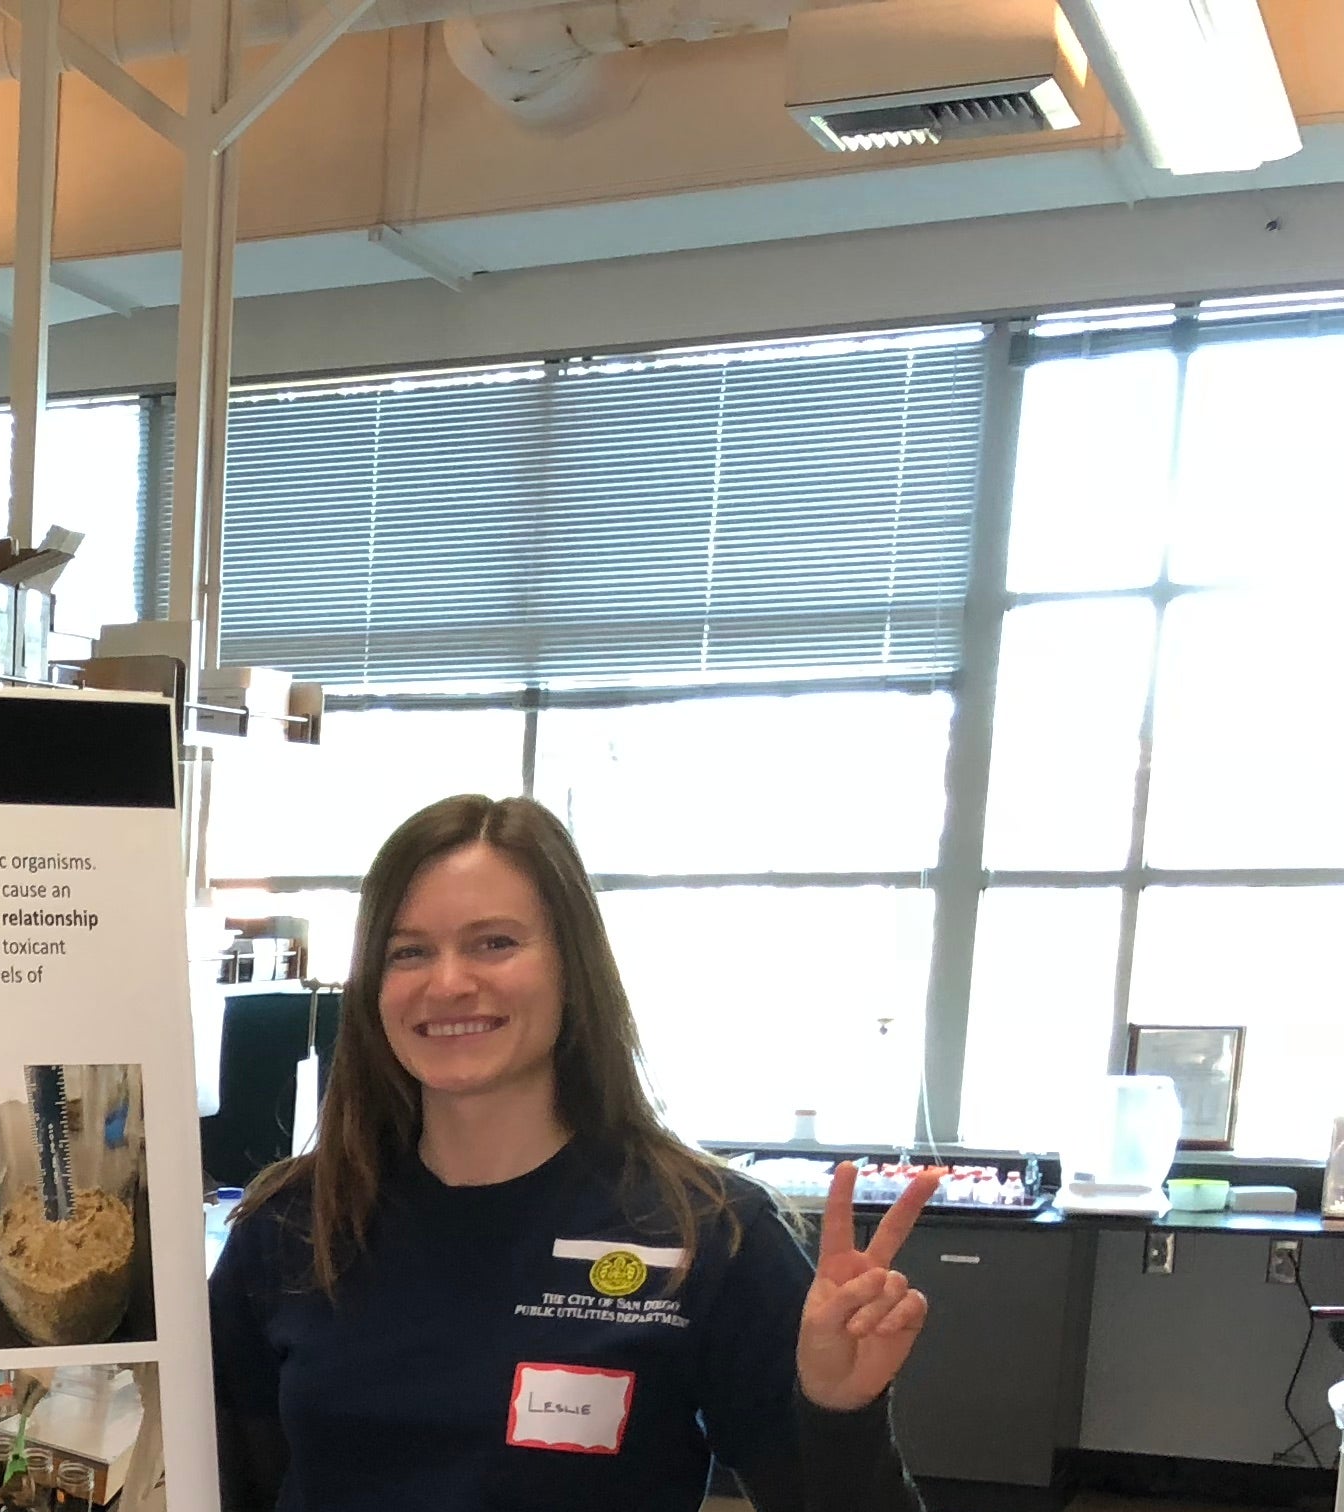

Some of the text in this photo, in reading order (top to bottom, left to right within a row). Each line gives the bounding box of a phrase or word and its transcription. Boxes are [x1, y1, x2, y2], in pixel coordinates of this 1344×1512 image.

[10, 852, 97, 874] organisms.
[1, 883, 47, 899] cause
[50, 884, 71, 899] an
[1, 907, 99, 931] relationship
[1, 937, 67, 956] toxicant
[542, 1292, 566, 1305] THE
[567, 1293, 596, 1307] CITY
[597, 1296, 615, 1308] OF
[513, 1304, 556, 1318] PUBLIC
[556, 1306, 616, 1322] UTILITIES
